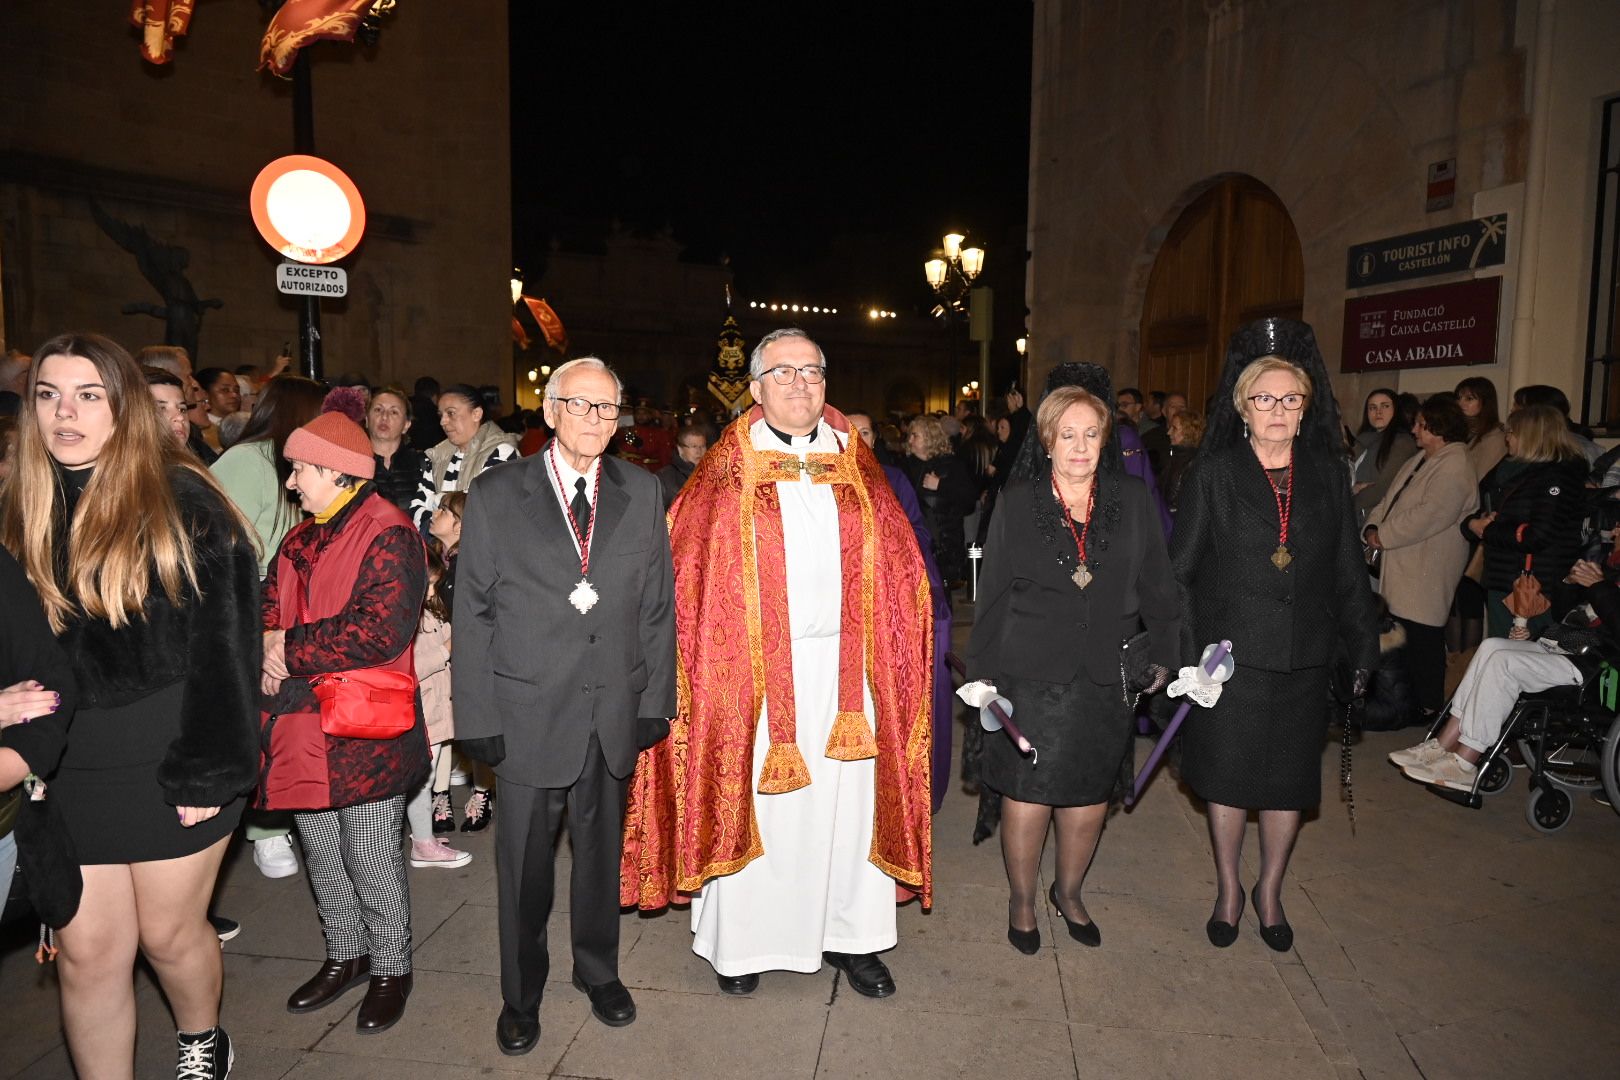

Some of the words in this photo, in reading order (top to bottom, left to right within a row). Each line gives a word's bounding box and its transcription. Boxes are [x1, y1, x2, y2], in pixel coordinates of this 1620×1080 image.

[1382, 241, 1435, 263] TOURIST
[1438, 234, 1471, 253] INFO
[286, 267, 338, 280] EXCEPTO
[280, 280, 344, 294] AUTORIZADOS
[1390, 324, 1420, 336] CAIXA
[1365, 348, 1402, 365] CASA
[1405, 343, 1464, 361] ABADIA
